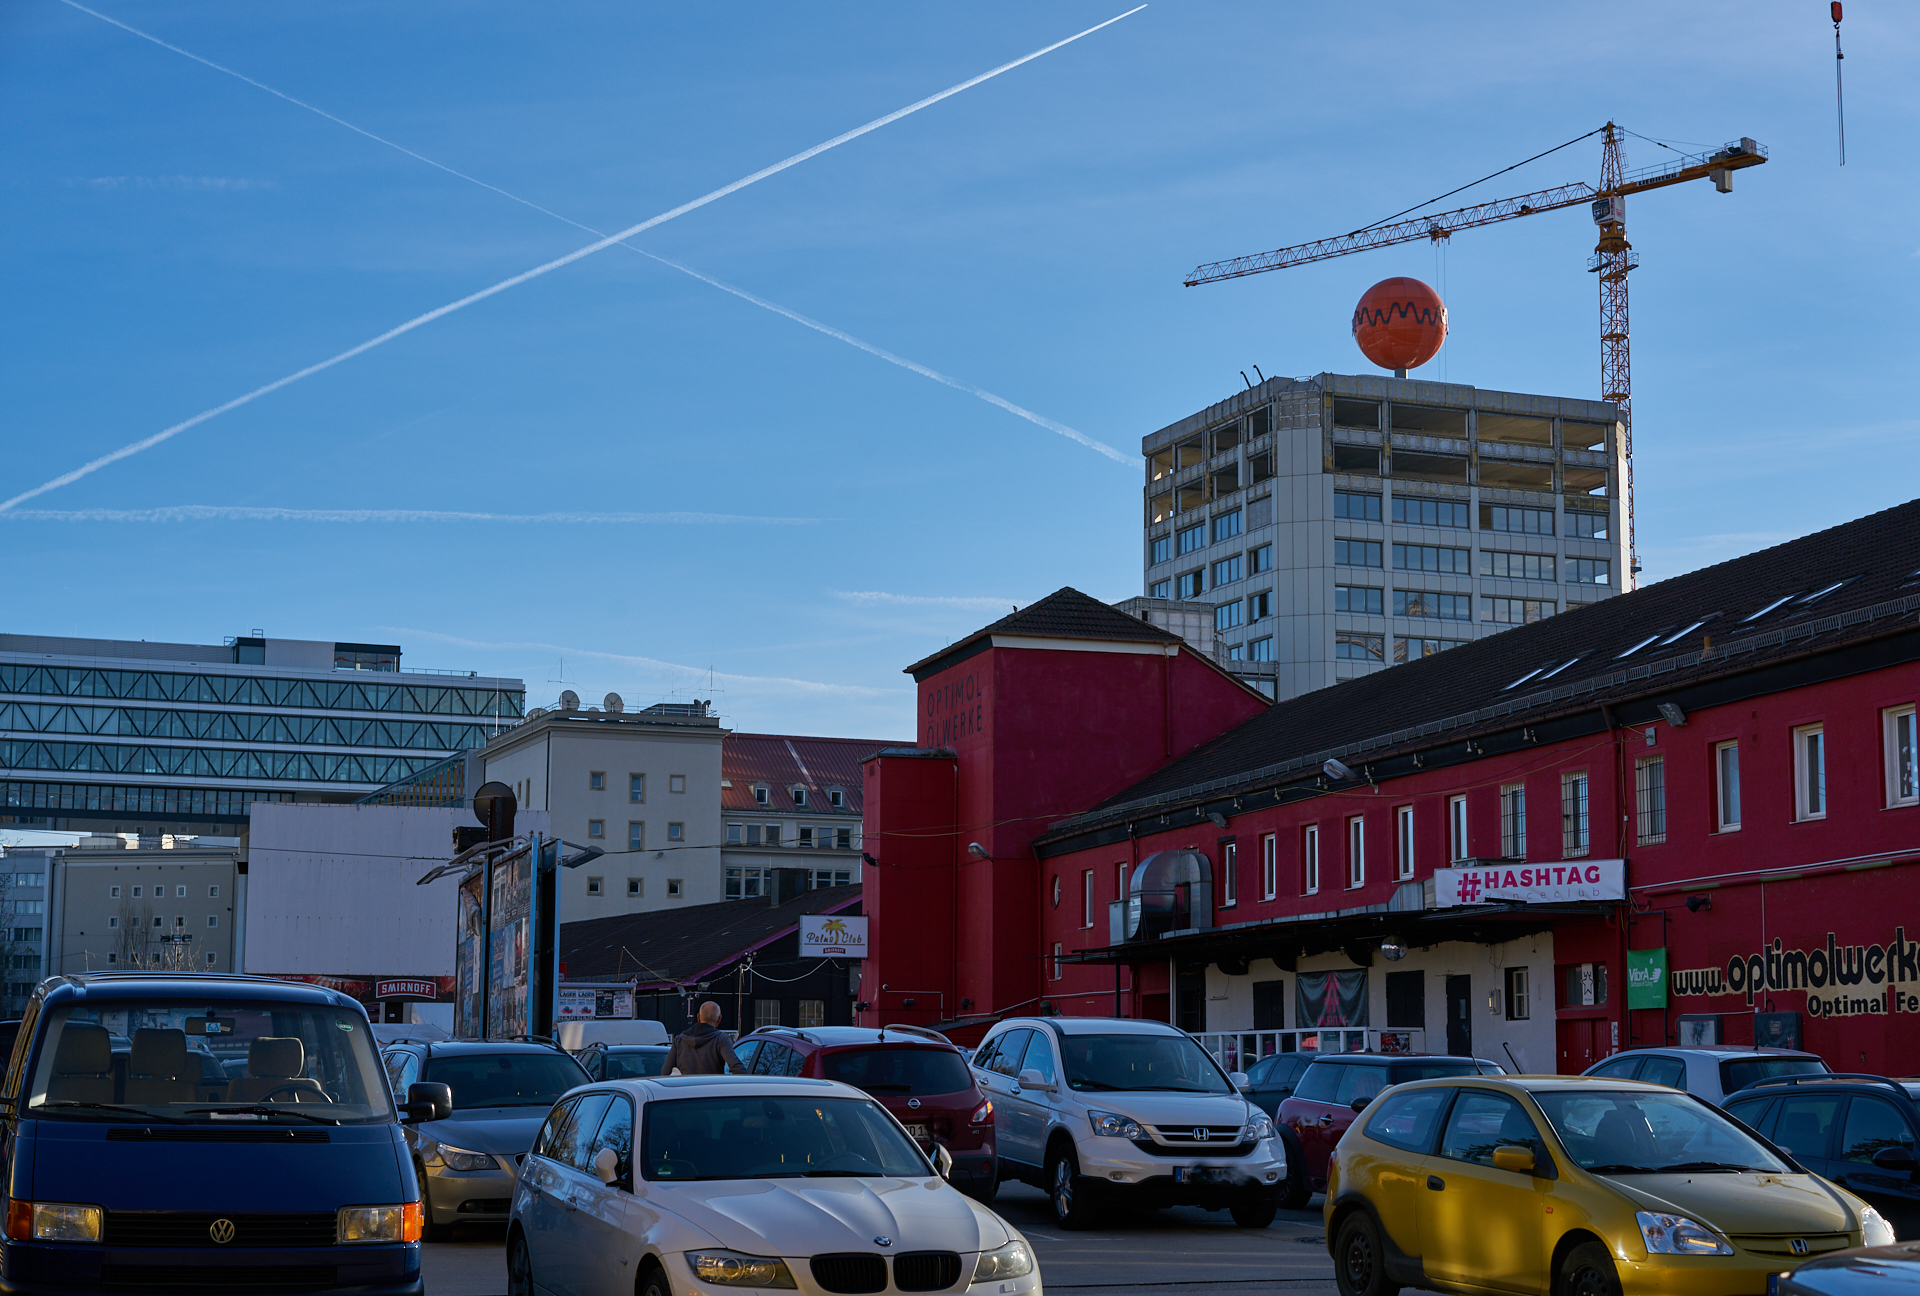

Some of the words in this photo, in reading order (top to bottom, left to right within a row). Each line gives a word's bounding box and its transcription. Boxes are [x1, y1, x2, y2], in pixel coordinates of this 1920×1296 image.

[927, 671, 982, 718] OPTIMOL
[926, 705, 982, 749] ÖLWERKE
[806, 932, 834, 943] Palms
[841, 932, 862, 944] Club
[1628, 967, 1650, 982] VibrA
[1673, 927, 1920, 1005] www.optimolwerk
[1808, 992, 1888, 1019] Optimal
